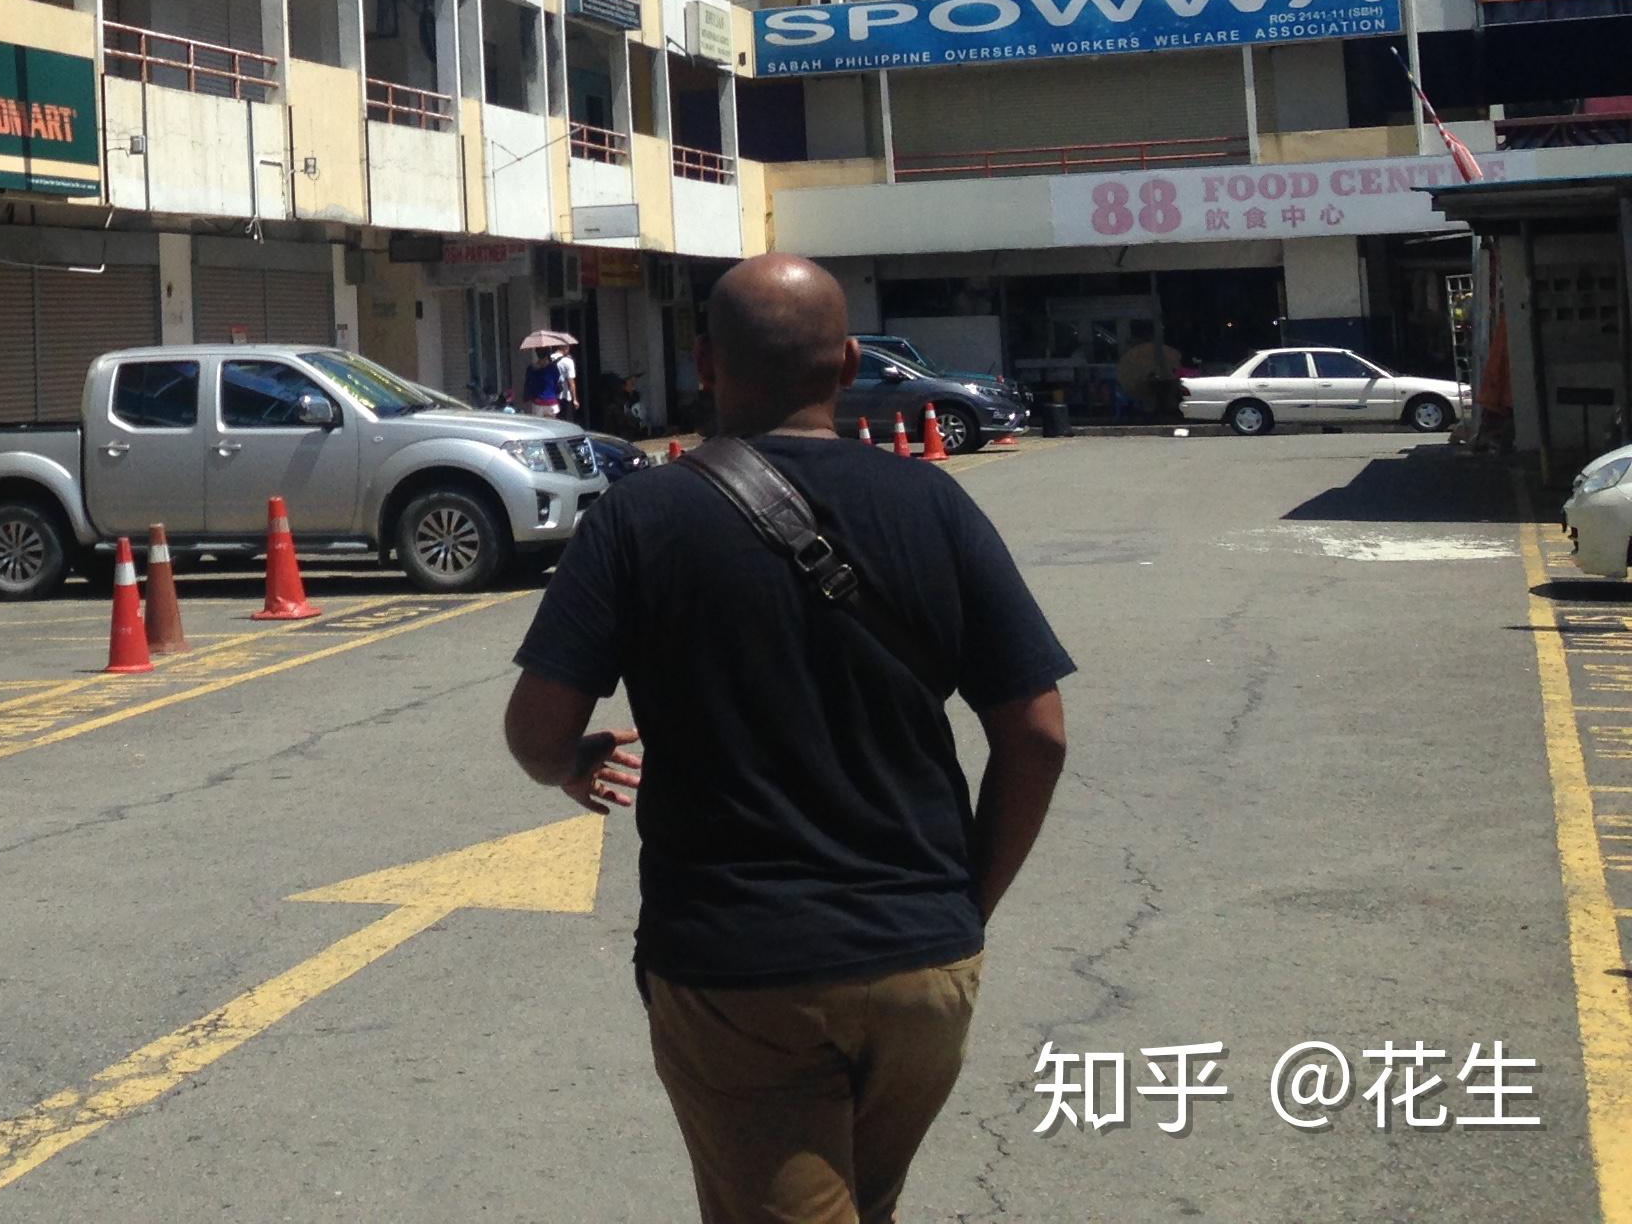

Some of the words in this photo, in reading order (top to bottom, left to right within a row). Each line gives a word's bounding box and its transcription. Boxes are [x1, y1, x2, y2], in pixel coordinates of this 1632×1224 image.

[1270, 12, 1295, 23] ROS
[1348, 6, 1383, 19] (SBH)
[768, 58, 822, 73] SABAH
[835, 51, 931, 68] PHILIPPINE
[945, 44, 1037, 61] OVERSEAS
[1051, 37, 1139, 54] WORKERS
[1154, 29, 1240, 47] WELFARE
[1255, 19, 1386, 39] ASSOCIATION
[1092, 179, 1182, 235] 88
[1201, 171, 1320, 202] FOOD
[1205, 203, 1345, 230] 飲食中心
